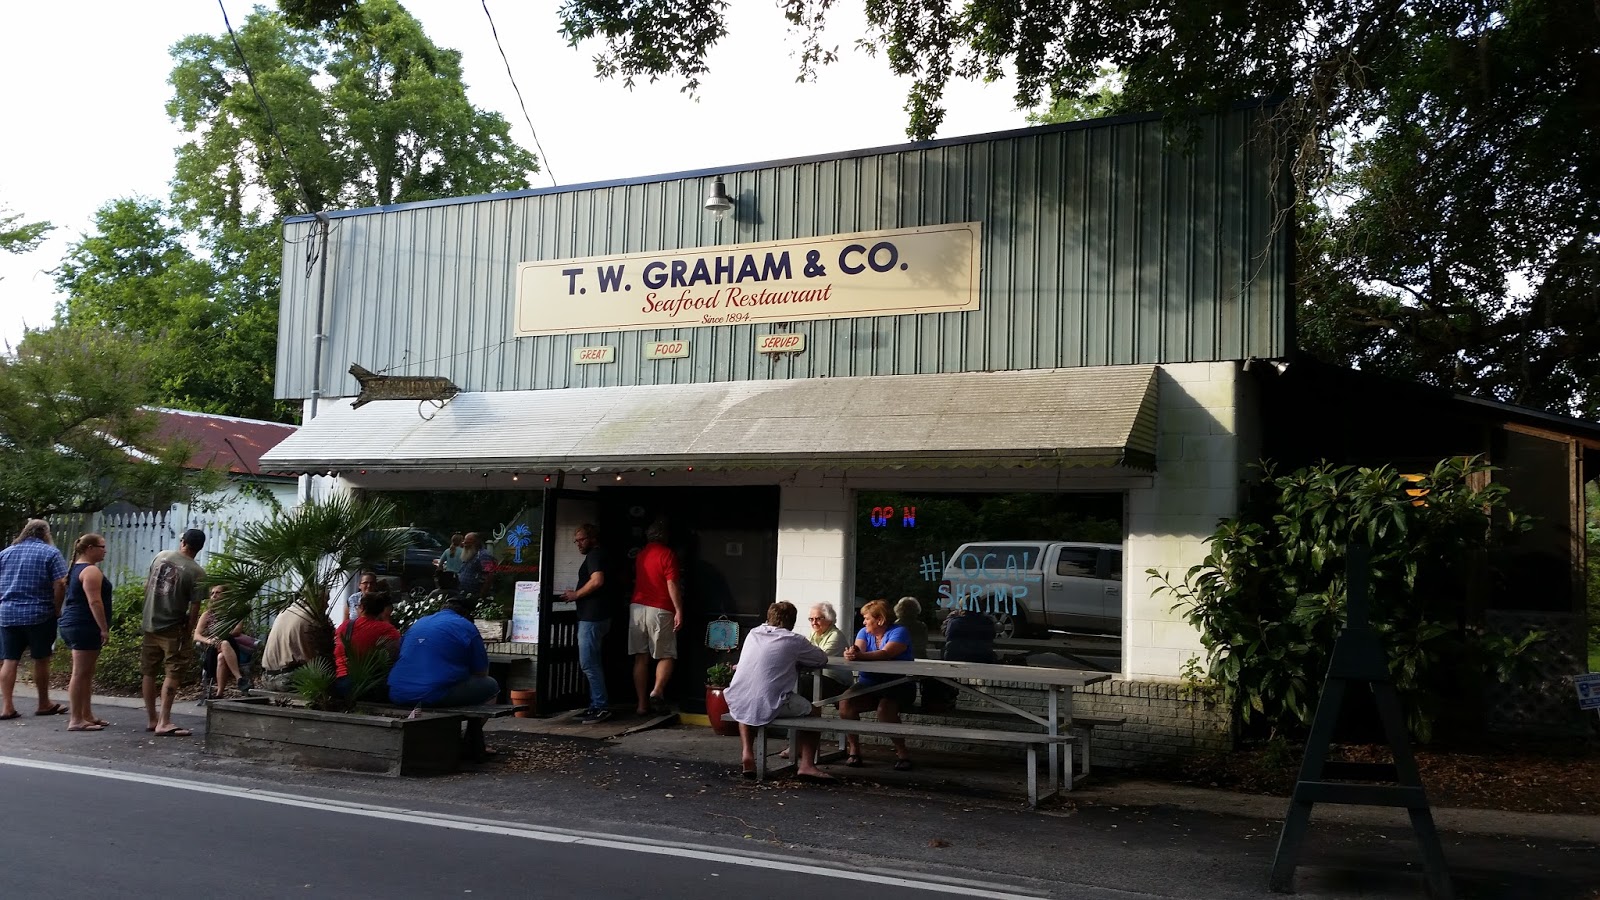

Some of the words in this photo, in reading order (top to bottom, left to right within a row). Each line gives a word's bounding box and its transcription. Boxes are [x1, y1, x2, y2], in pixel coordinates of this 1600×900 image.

[562, 267, 587, 296] T.
[597, 264, 632, 293] W.
[642, 250, 793, 290] GRAHAM
[803, 249, 827, 279] &
[838, 241, 909, 275] CO.
[641, 289, 720, 318] Seafood
[725, 283, 833, 308] Restaurant
[701, 313, 724, 325] Since
[580, 349, 608, 361] GREAT
[654, 343, 683, 356] FOOD
[761, 336, 800, 349] SERVED
[870, 506, 917, 528] OPN
[919, 550, 1041, 583] #LOCAL
